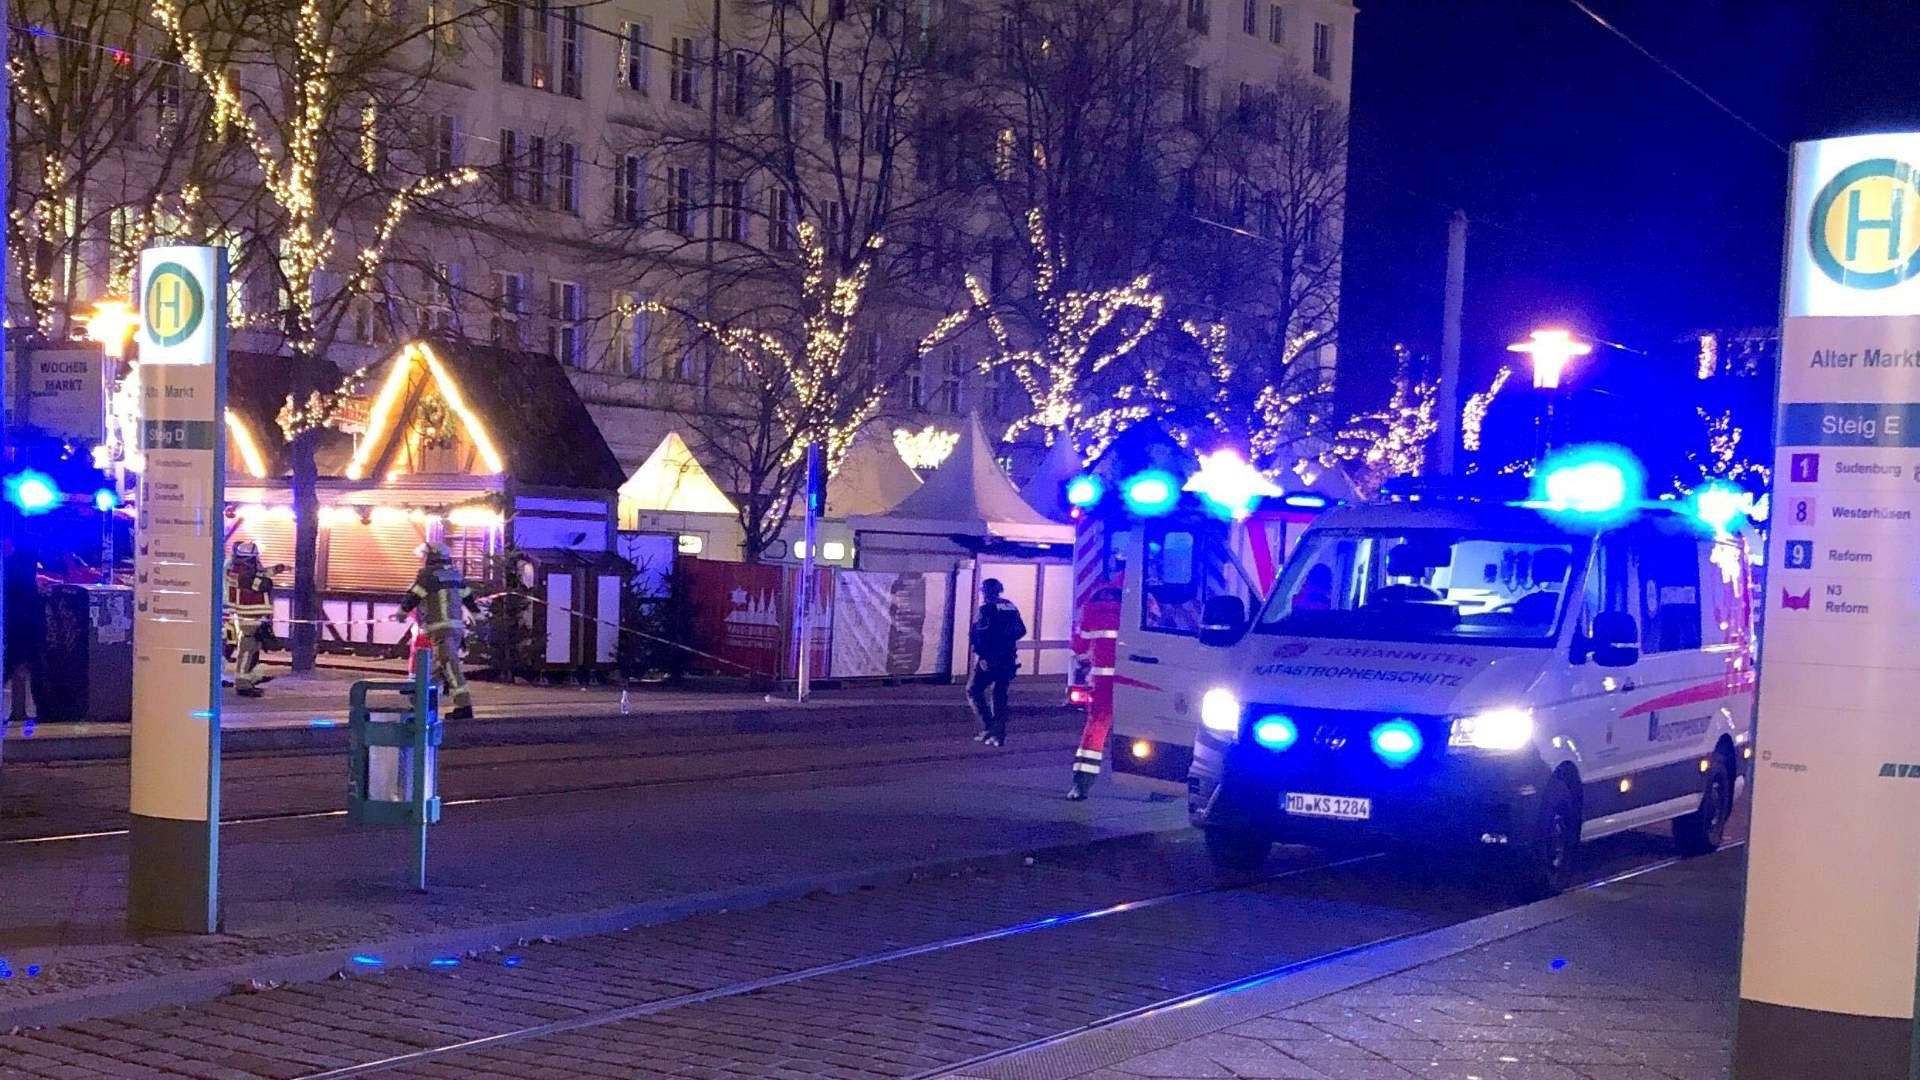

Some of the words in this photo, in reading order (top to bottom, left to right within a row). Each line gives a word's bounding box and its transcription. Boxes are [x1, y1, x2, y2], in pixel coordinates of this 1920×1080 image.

[1846, 188, 1904, 261] H
[155, 281, 181, 329] H
[40, 362, 87, 373] WOCHEN
[1810, 350, 1857, 368] Alter
[1864, 349, 1920, 368] Markt
[44, 380, 82, 391] MARKT
[165, 385, 194, 398] Markt
[175, 429, 185, 441] D
[1822, 415, 1876, 438] Steig
[1884, 416, 1900, 434] E
[1800, 458, 1810, 479] 1
[1835, 462, 1902, 478] Sudenburg
[1796, 501, 1807, 522] 8
[1793, 544, 1804, 564] 9
[1828, 549, 1873, 562] Reform
[1826, 584, 1842, 596] N3
[1825, 600, 1869, 614] Reform
[1286, 795, 1304, 811] MD
[1314, 798, 1331, 813] KS
[1334, 800, 1367, 816] 1284
